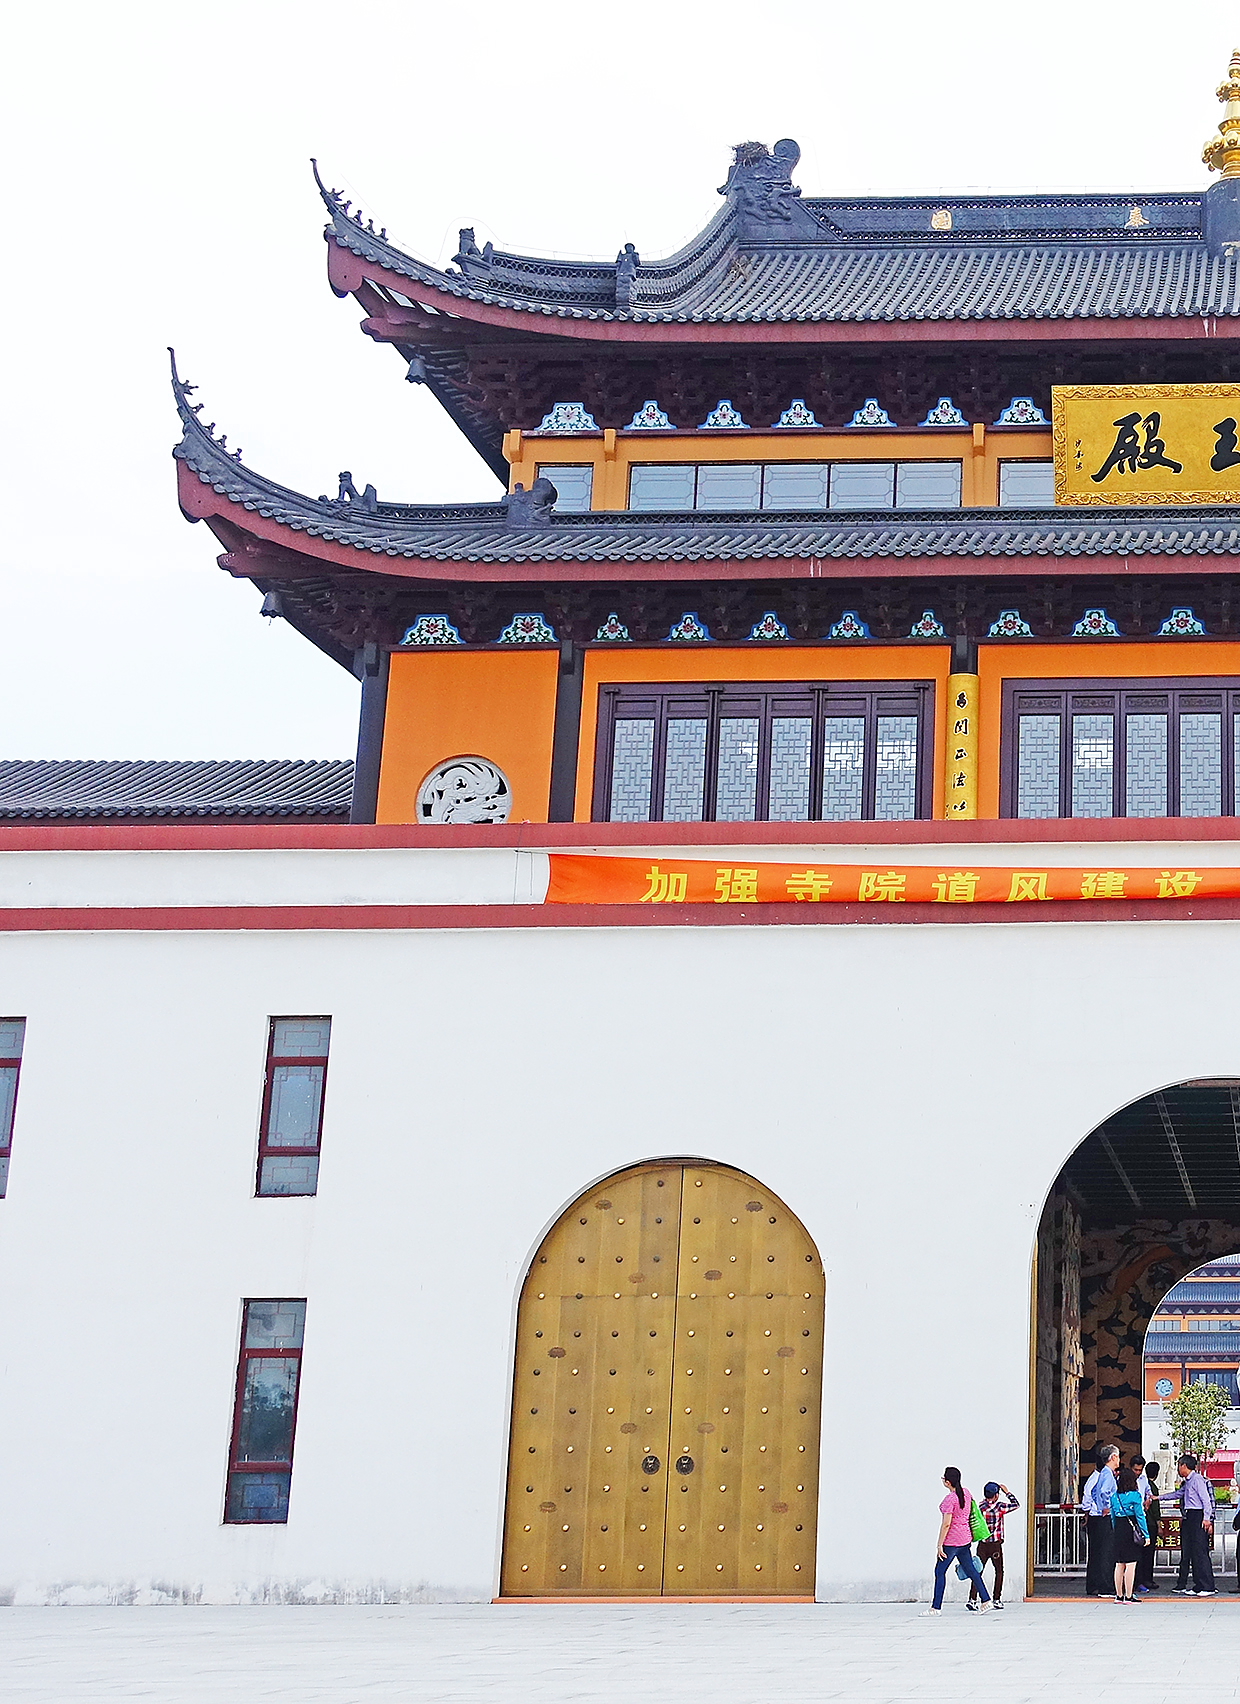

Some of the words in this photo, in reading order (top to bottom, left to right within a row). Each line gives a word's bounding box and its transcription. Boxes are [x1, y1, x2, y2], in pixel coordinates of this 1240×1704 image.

[639, 866, 1203, 903] 加强寺院道风建设
